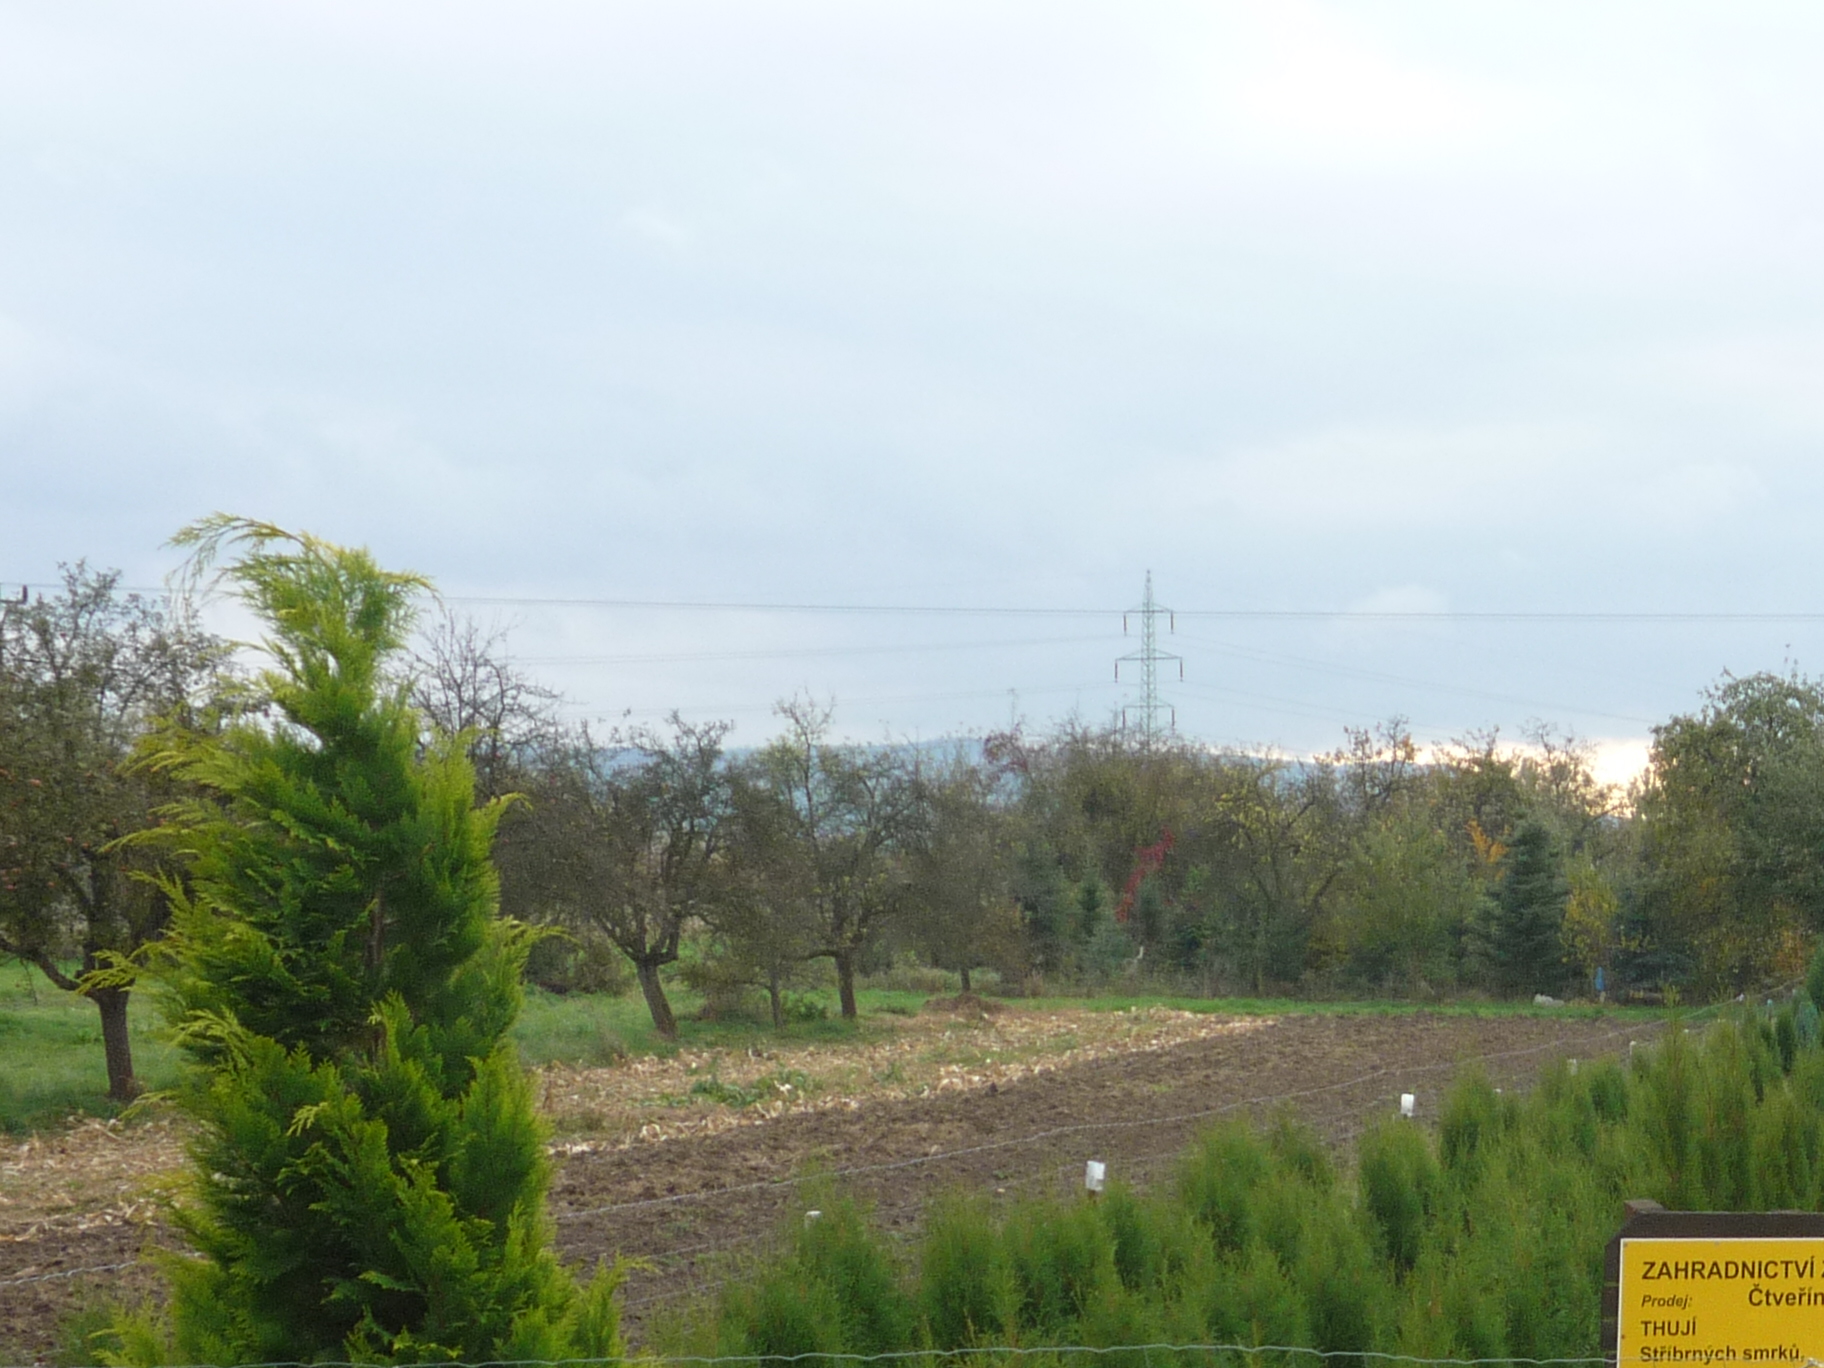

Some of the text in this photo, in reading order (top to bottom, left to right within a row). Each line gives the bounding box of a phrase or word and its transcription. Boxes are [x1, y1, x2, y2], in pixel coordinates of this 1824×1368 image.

[1642, 1257, 1815, 1280] ZAHRADNICTVÍ
[1641, 1295, 1693, 1309] Prodej:
[1641, 1317, 1697, 1336] THUJÍ
[1640, 1346, 1736, 1362] Stříbrných
